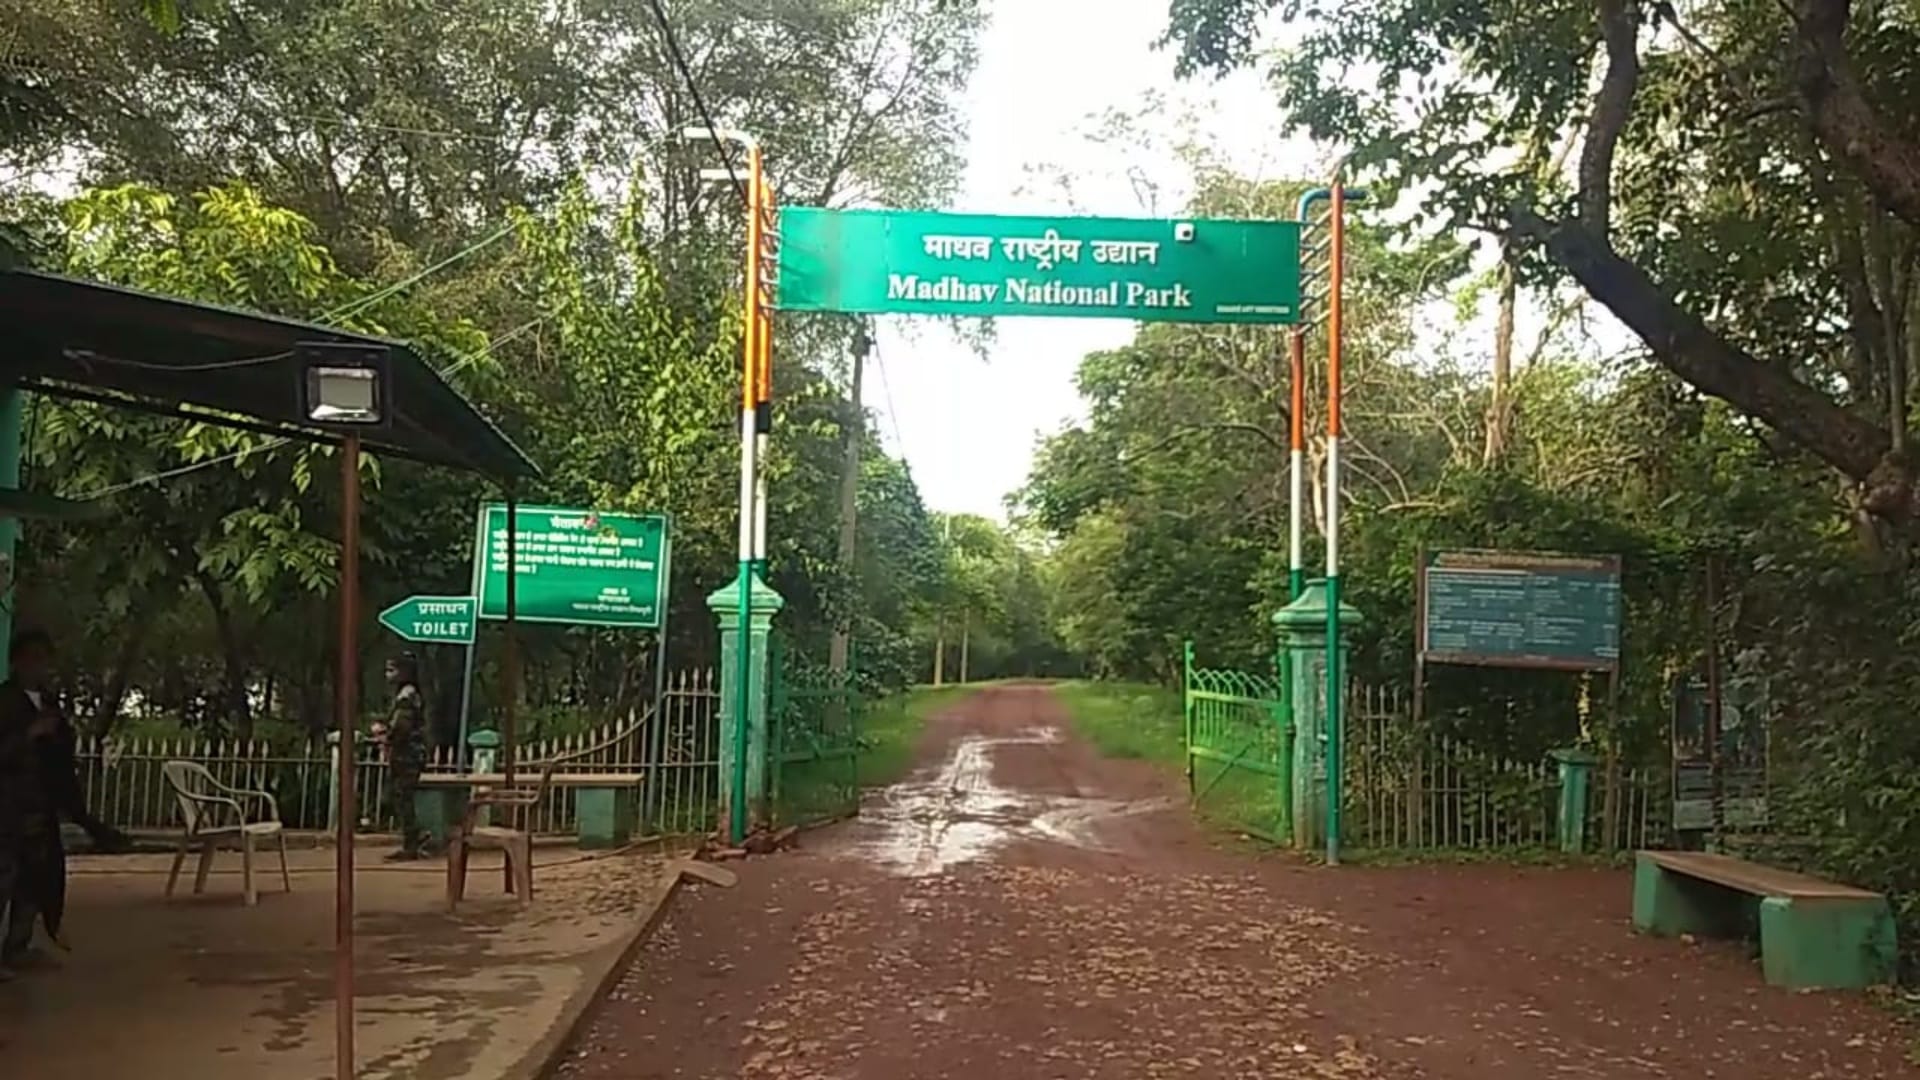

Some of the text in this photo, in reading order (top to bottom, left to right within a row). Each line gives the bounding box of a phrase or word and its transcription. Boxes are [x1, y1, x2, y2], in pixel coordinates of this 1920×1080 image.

[922, 229, 1159, 269] माधव राष्ट्रीय उद्यान
[887, 274, 1192, 307] Madhav National Park
[418, 602, 468, 615] प्रसाधन
[412, 622, 469, 635] TOILET
